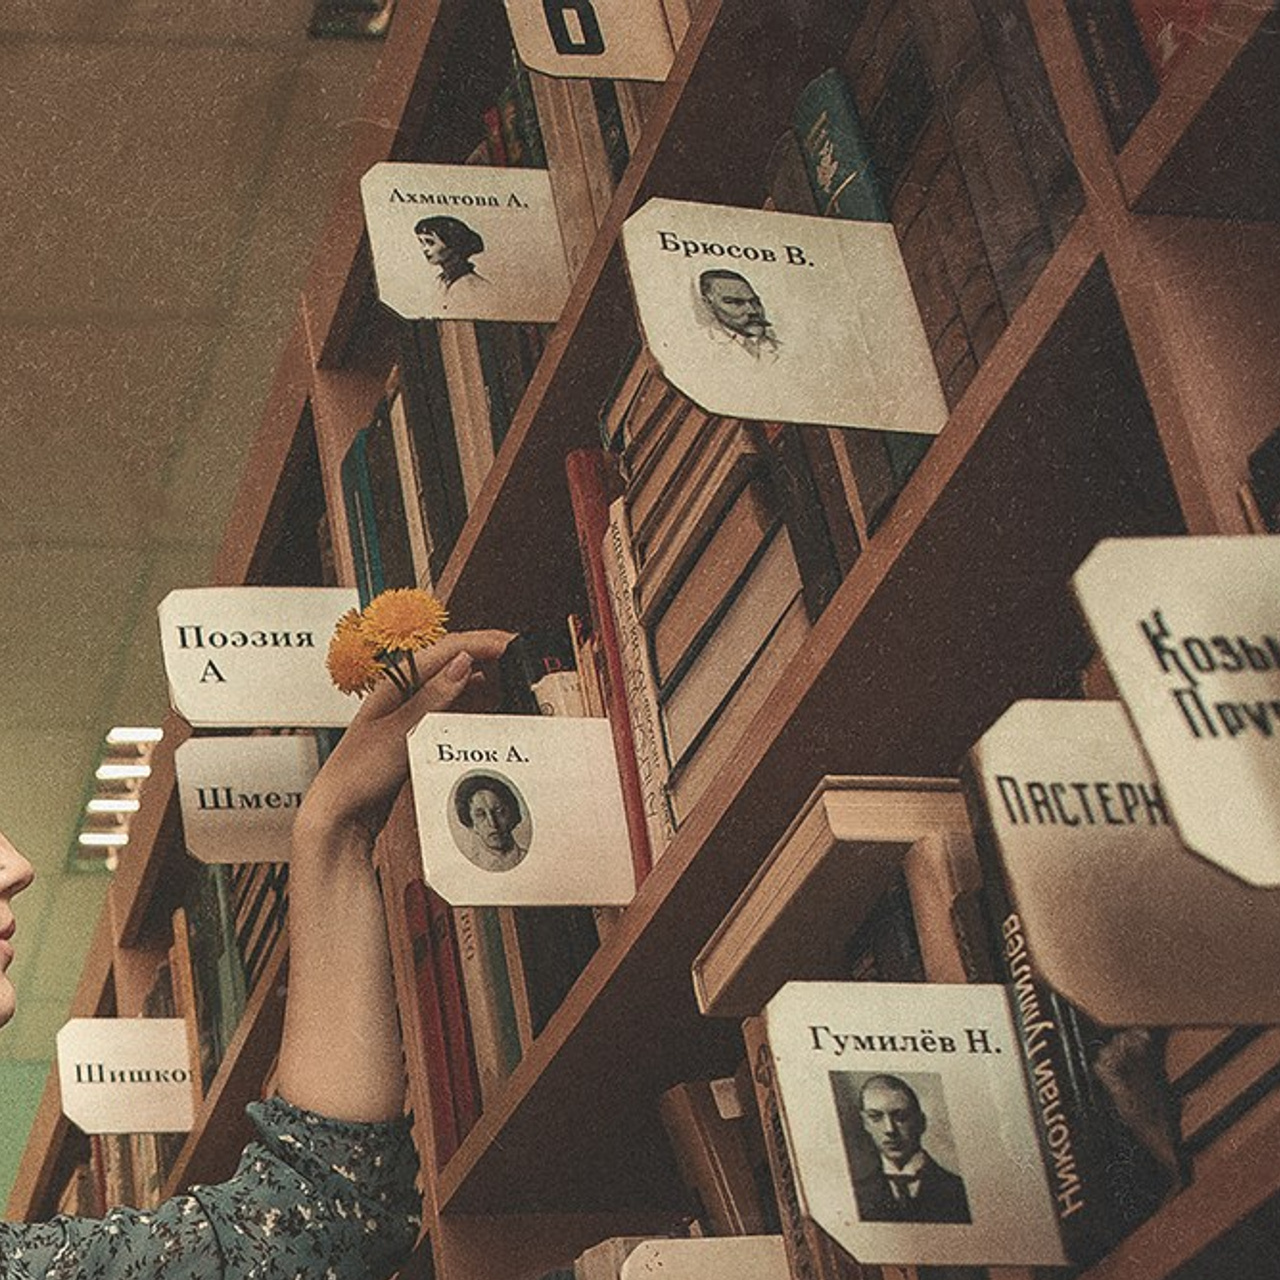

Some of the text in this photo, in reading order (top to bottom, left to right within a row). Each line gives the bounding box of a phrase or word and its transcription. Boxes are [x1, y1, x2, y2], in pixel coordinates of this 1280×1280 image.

[389, 188, 530, 209] Ахматова А.
[657, 230, 815, 268] Брюсов В.
[177, 625, 315, 648] Поэзия
[1139, 609, 1280, 688] КОЗЬ
[199, 659, 227, 683] А
[1171, 688, 1280, 737] ПРУ
[436, 743, 530, 762] Блок А.
[808, 1025, 1002, 1056] Гумилёв Н.
